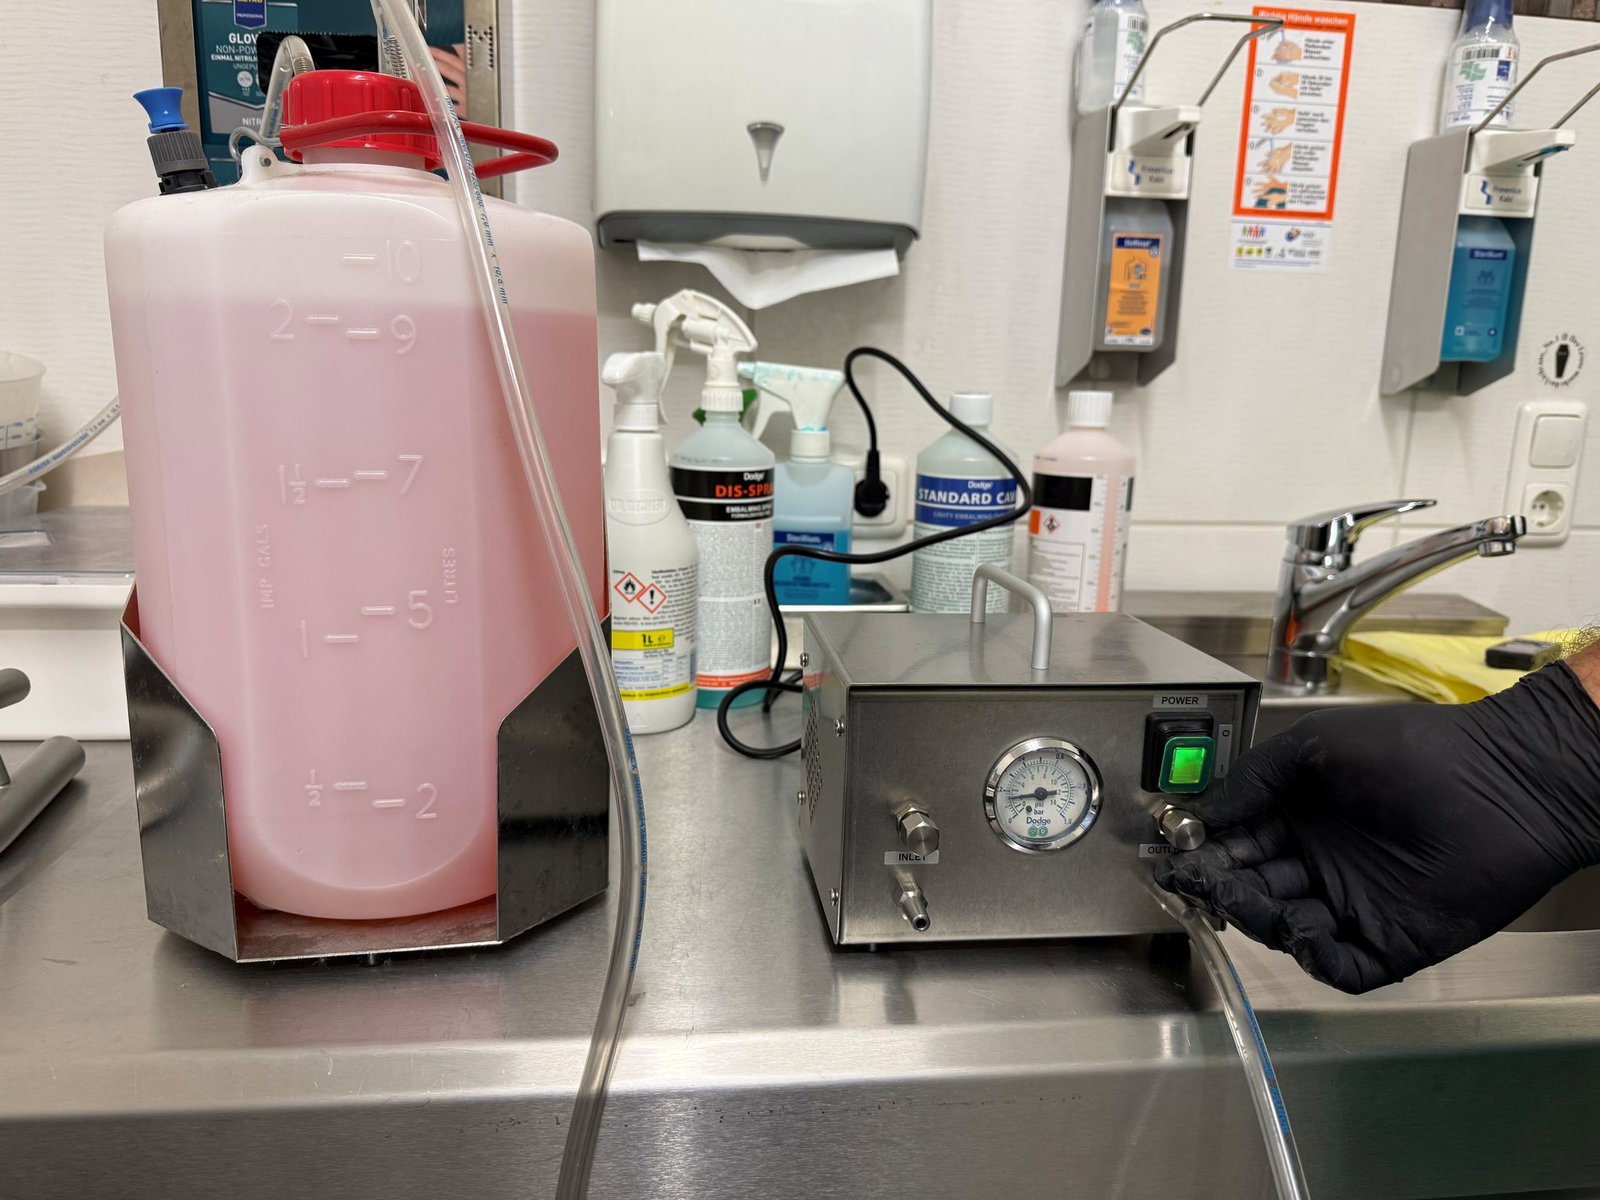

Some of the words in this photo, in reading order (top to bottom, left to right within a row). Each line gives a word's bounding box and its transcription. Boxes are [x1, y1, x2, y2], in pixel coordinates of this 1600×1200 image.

[228, 33, 259, 44] GLOV
[216, 45, 257, 54] NON-POW
[243, 117, 262, 125] NITR
[386, 239, 421, 284] 10
[270, 297, 294, 341] 2
[390, 313, 417, 356] 9
[398, 453, 424, 496] 7
[967, 481, 992, 491] Dodge
[918, 488, 992, 505] STANDARD
[442, 546, 458, 605] LITRES
[408, 589, 434, 630] 5
[1161, 696, 1200, 705] POWER
[415, 782, 438, 820] 2
[1026, 816, 1051, 826] Dodge
[1147, 846, 1180, 854] OUTLE
